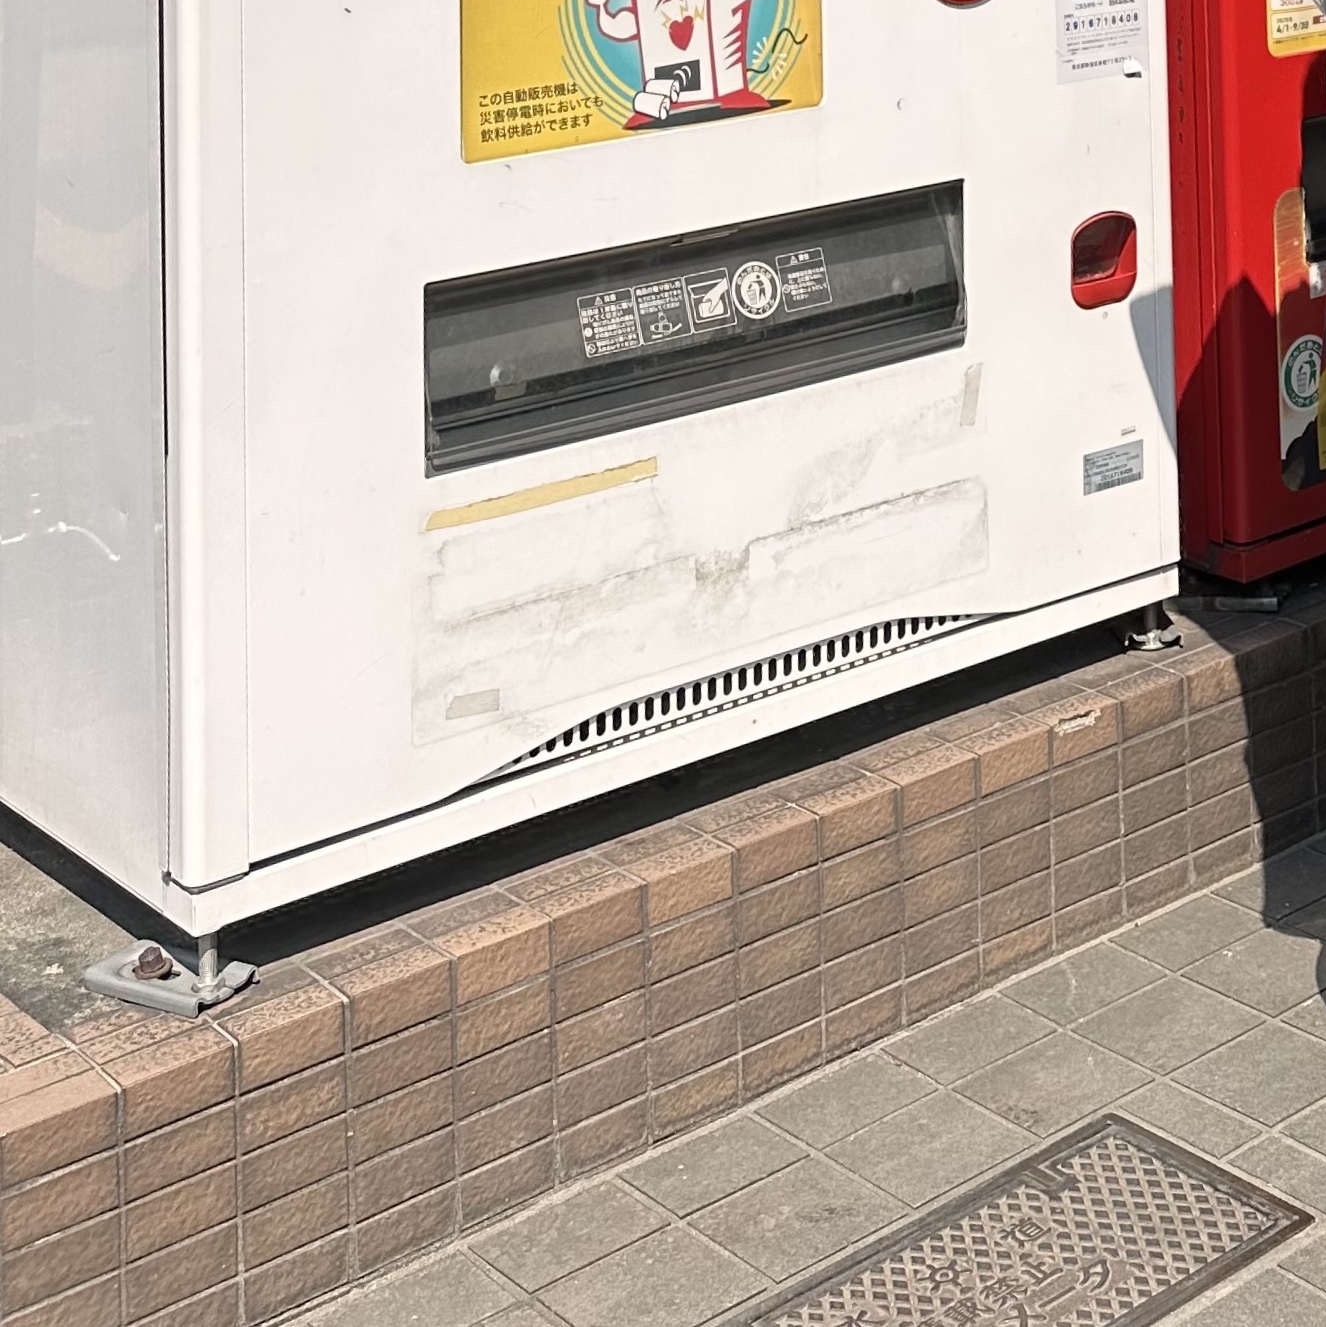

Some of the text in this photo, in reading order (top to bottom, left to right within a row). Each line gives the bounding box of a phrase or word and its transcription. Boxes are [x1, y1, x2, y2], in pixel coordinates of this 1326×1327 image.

[479, 82, 579, 108] この自動販売機は
[480, 95, 604, 127] 災害停電時においても
[480, 113, 593, 143] 飲料供給ができます
